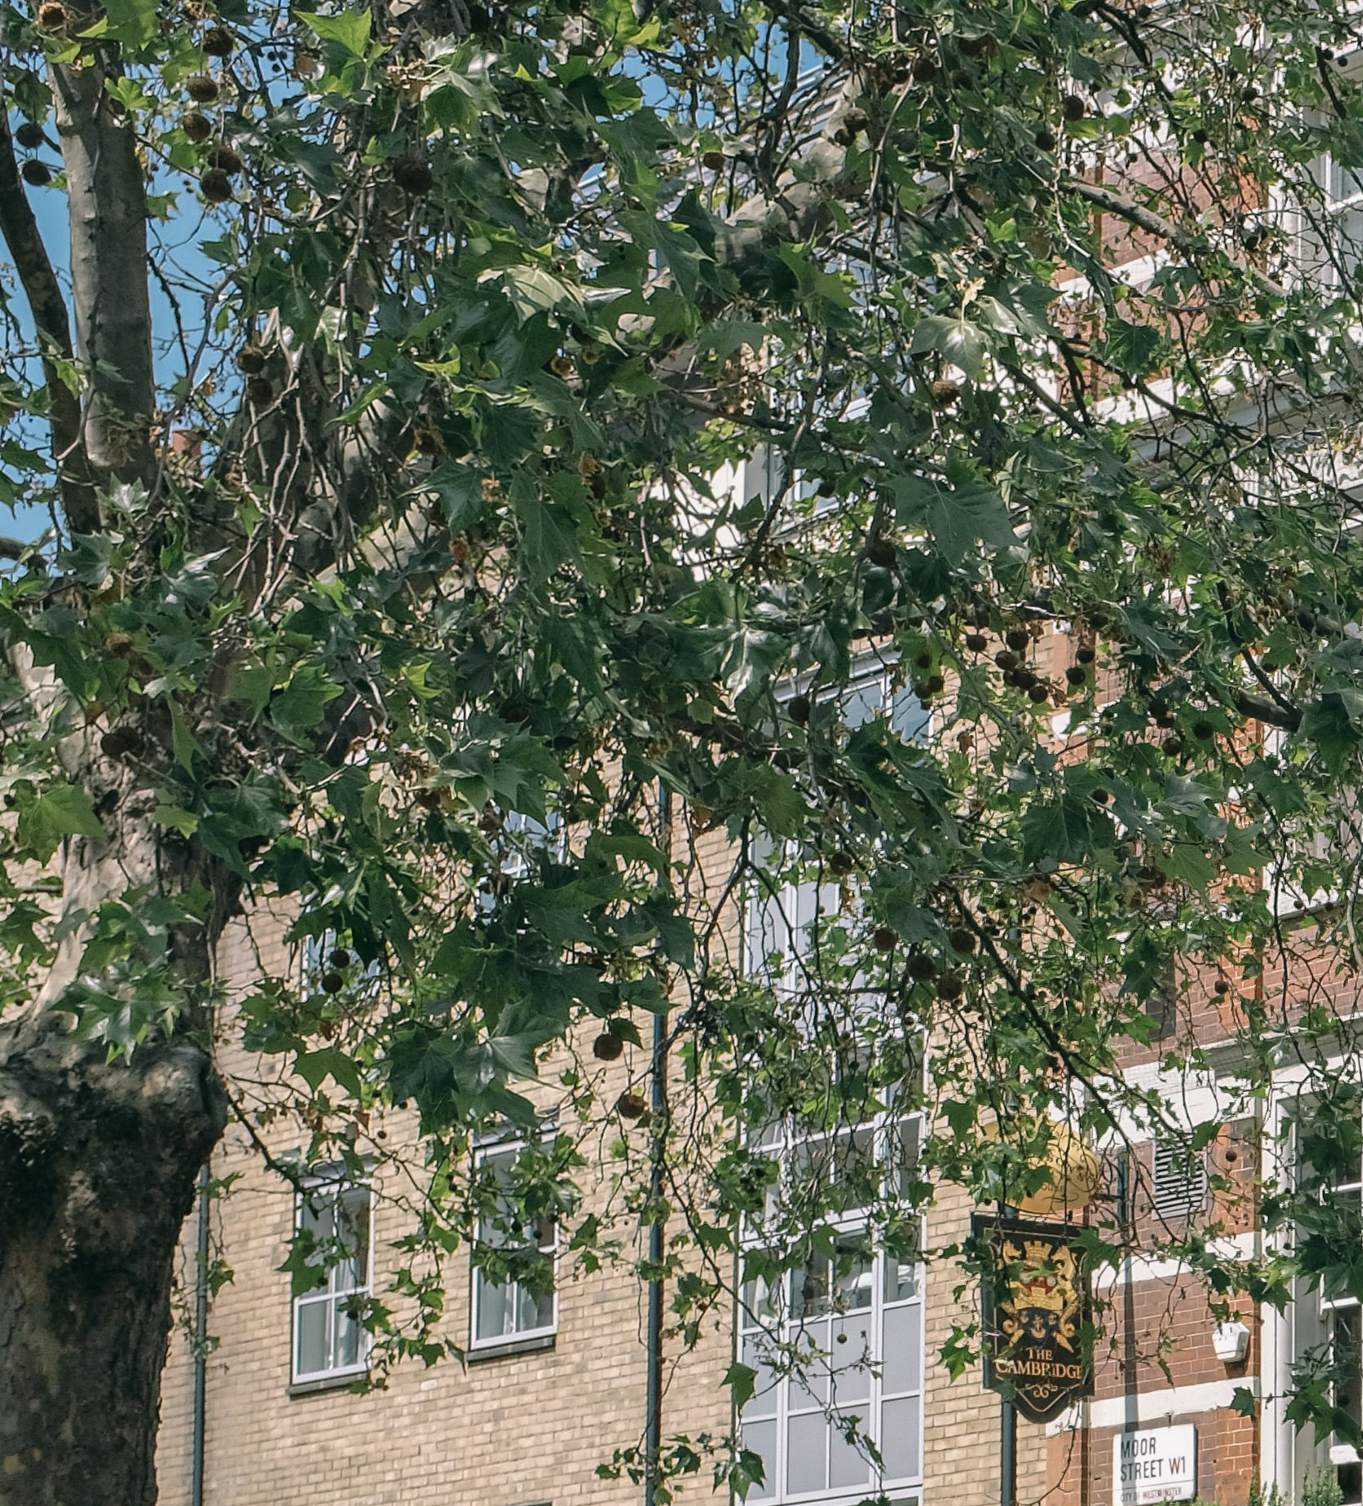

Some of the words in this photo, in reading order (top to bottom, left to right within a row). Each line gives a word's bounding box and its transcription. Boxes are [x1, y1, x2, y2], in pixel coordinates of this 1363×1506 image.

[1025, 1345, 1053, 1361] THE
[1120, 1436, 1157, 1459] MOOR
[1120, 1458, 1164, 1483] STREET
[1168, 1455, 1186, 1476] W1
